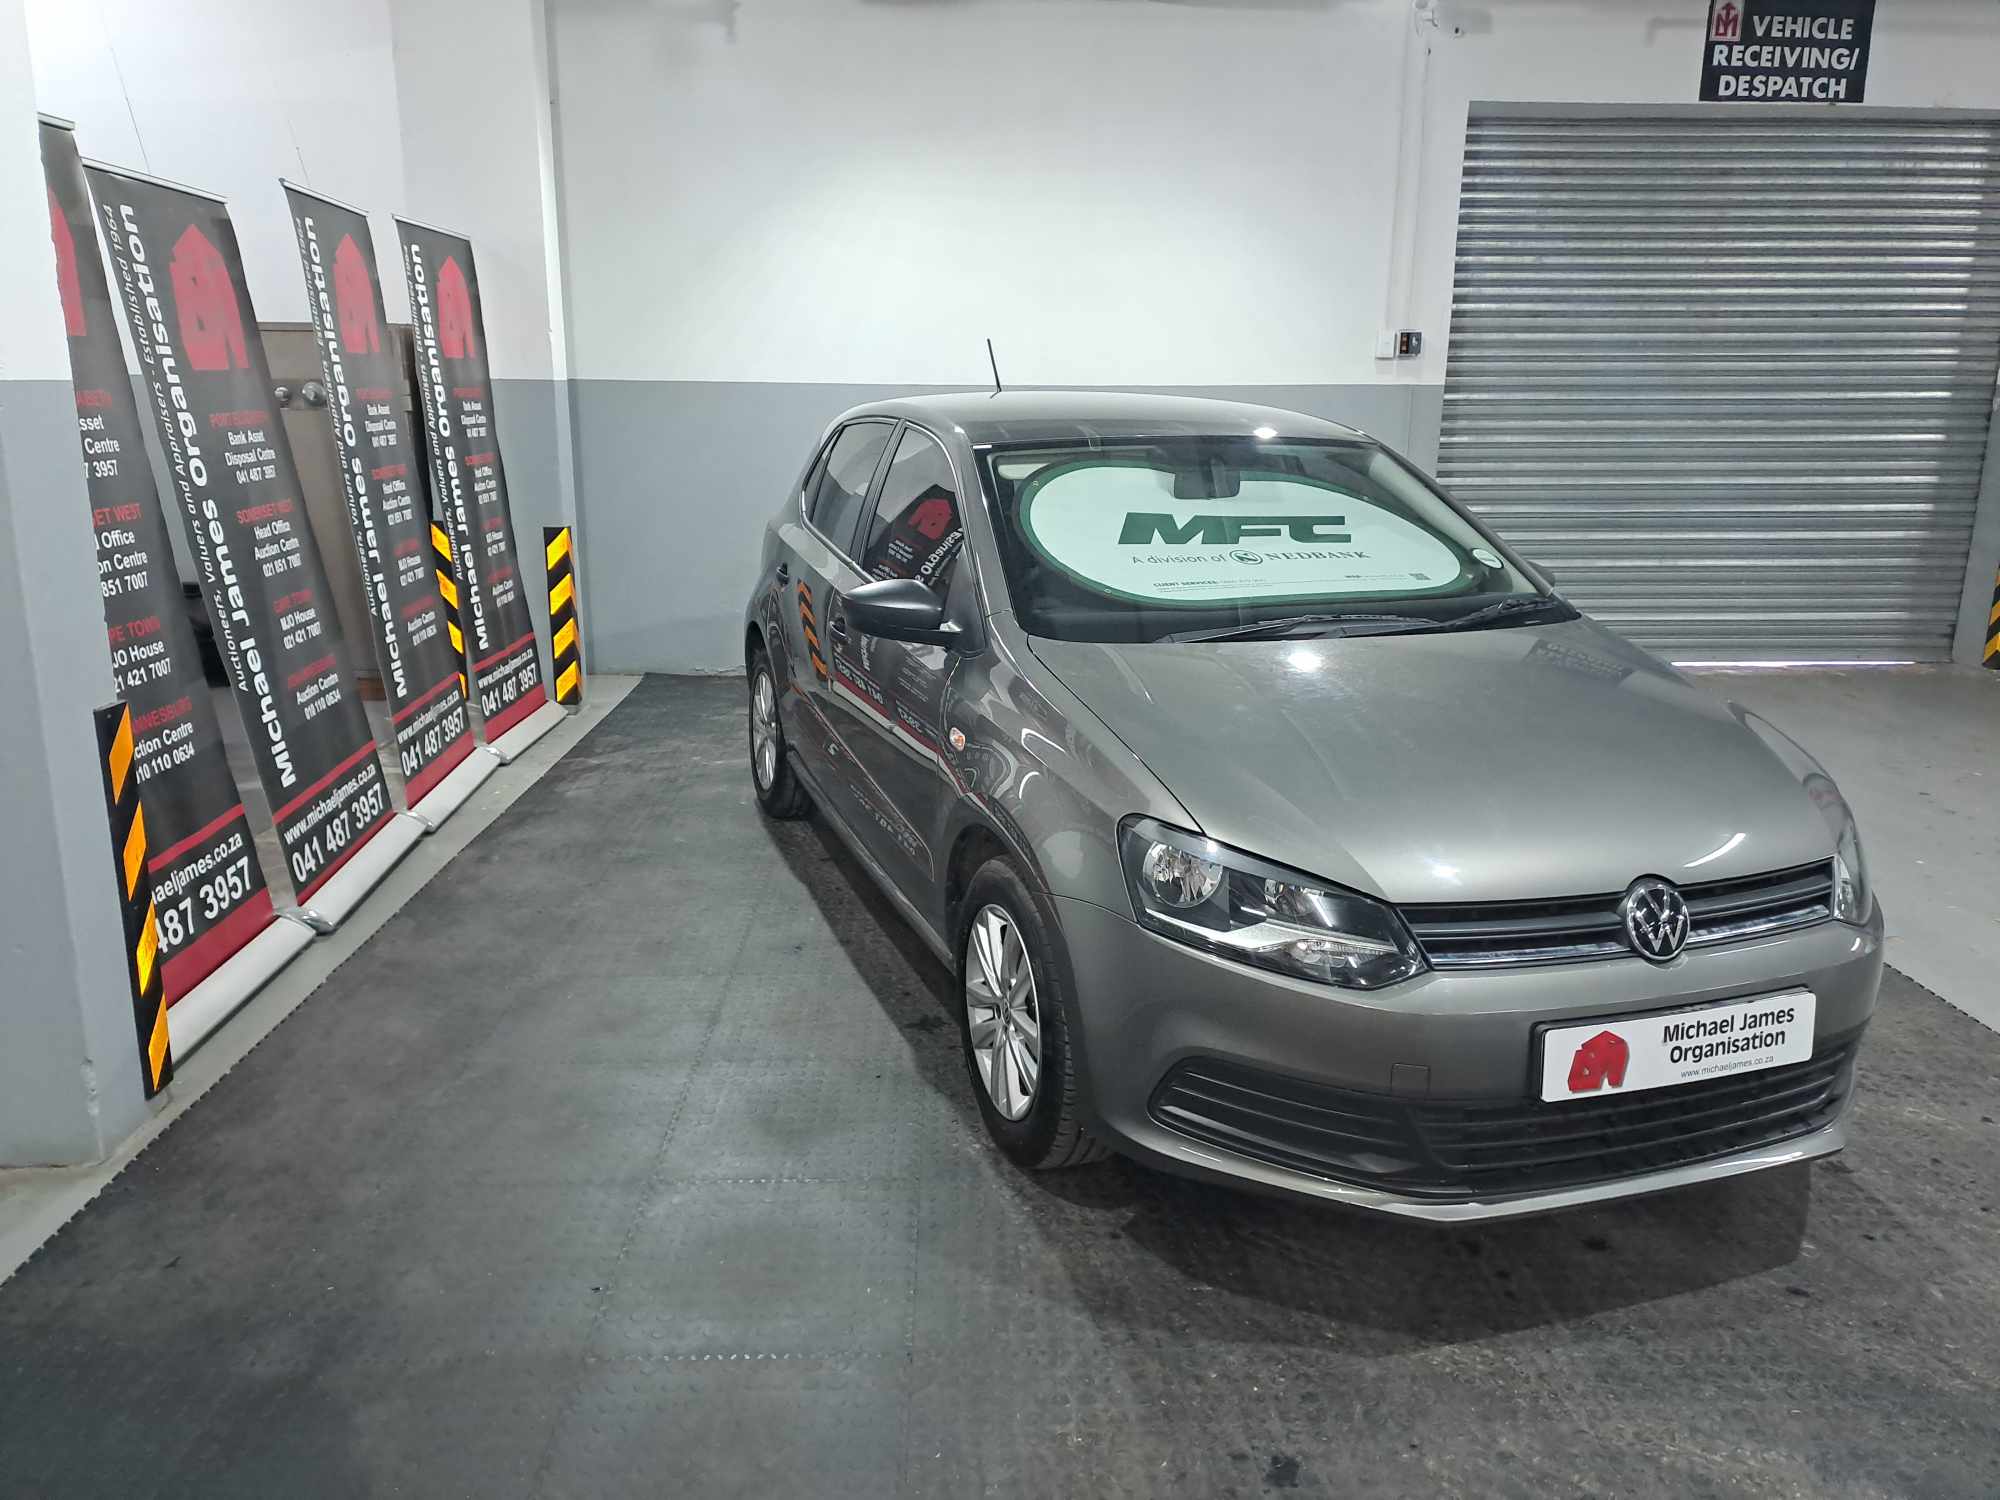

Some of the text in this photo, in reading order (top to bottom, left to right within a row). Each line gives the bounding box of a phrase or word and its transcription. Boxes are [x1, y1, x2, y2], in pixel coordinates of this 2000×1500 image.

[1752, 15, 1855, 40] VEHICLE
[1712, 44, 1860, 71] RECEIVING/
[1717, 75, 1848, 99] DESPATCH
[103, 204, 124, 251] 1964
[116, 256, 155, 364] Established
[119, 204, 208, 487] Organisation
[304, 217, 356, 447] Organisation
[420, 364, 436, 429] Appraisers
[79, 414, 104, 431] sset
[153, 381, 187, 477] Appraisers
[227, 430, 248, 445] Bank
[84, 437, 120, 454] Centre
[224, 448, 258, 466] Disposal
[337, 441, 347, 469] and
[411, 244, 488, 650] Michael James Organisation
[430, 431, 440, 455] and
[93, 459, 118, 477] 3957
[236, 469, 250, 484] 041
[249, 467, 263, 481] 487
[435, 459, 449, 503] Valuers
[178, 480, 197, 514] and
[344, 472, 359, 525] Valuers
[352, 457, 380, 563] James
[101, 530, 135, 548] Office
[254, 523, 272, 540] Head
[1118, 512, 1352, 545] MFC
[113, 551, 148, 570] Centre
[192, 519, 216, 583] Valuers
[202, 499, 250, 628] James
[254, 543, 281, 560] Auction
[1132, 550, 1371, 566] A division of NEDBANK
[101, 571, 148, 597] 851 7007
[356, 531, 379, 616] Auctioneers,
[108, 625, 125, 643] PE
[213, 589, 249, 692] Auctioneers,
[372, 573, 407, 698] Michael
[112, 640, 165, 668] JO House
[114, 658, 171, 693] 21 421 7007
[481, 662, 537, 716] 041 487 3957
[296, 684, 320, 705] Auction
[239, 637, 297, 788] Michael
[135, 721, 194, 761] ction Centre
[152, 754, 172, 774] 110
[173, 741, 195, 765] 0634
[401, 706, 464, 776] 041 487 3957
[283, 764, 376, 845] www.michaeljames.co.za
[292, 782, 384, 882] 041 487 3957
[200, 855, 251, 920] 3957
[1663, 1007, 1795, 1043] Michael James
[1670, 1030, 1786, 1063] Organisation
[1680, 1055, 1774, 1078] www.michaeljames.co.za
